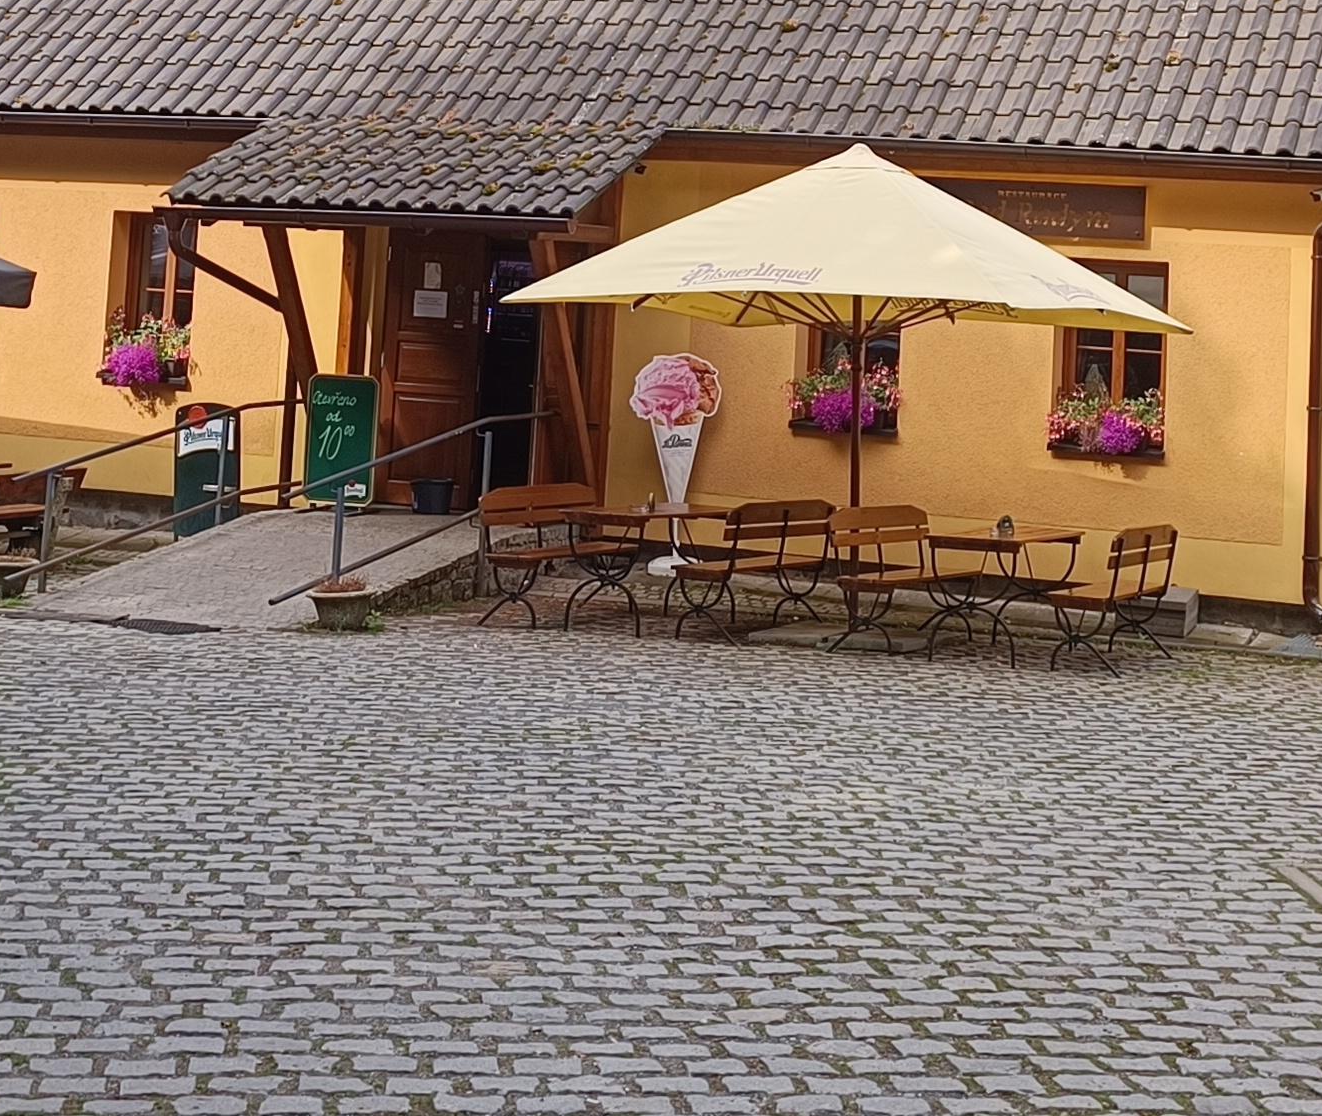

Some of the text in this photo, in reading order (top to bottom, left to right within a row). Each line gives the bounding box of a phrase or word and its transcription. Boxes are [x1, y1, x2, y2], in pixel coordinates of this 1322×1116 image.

[997, 189, 1068, 199] RESTAURACE
[677, 261, 824, 288] Pilsner Urquell
[312, 390, 357, 406] Otevřeno
[325, 410, 343, 422] od
